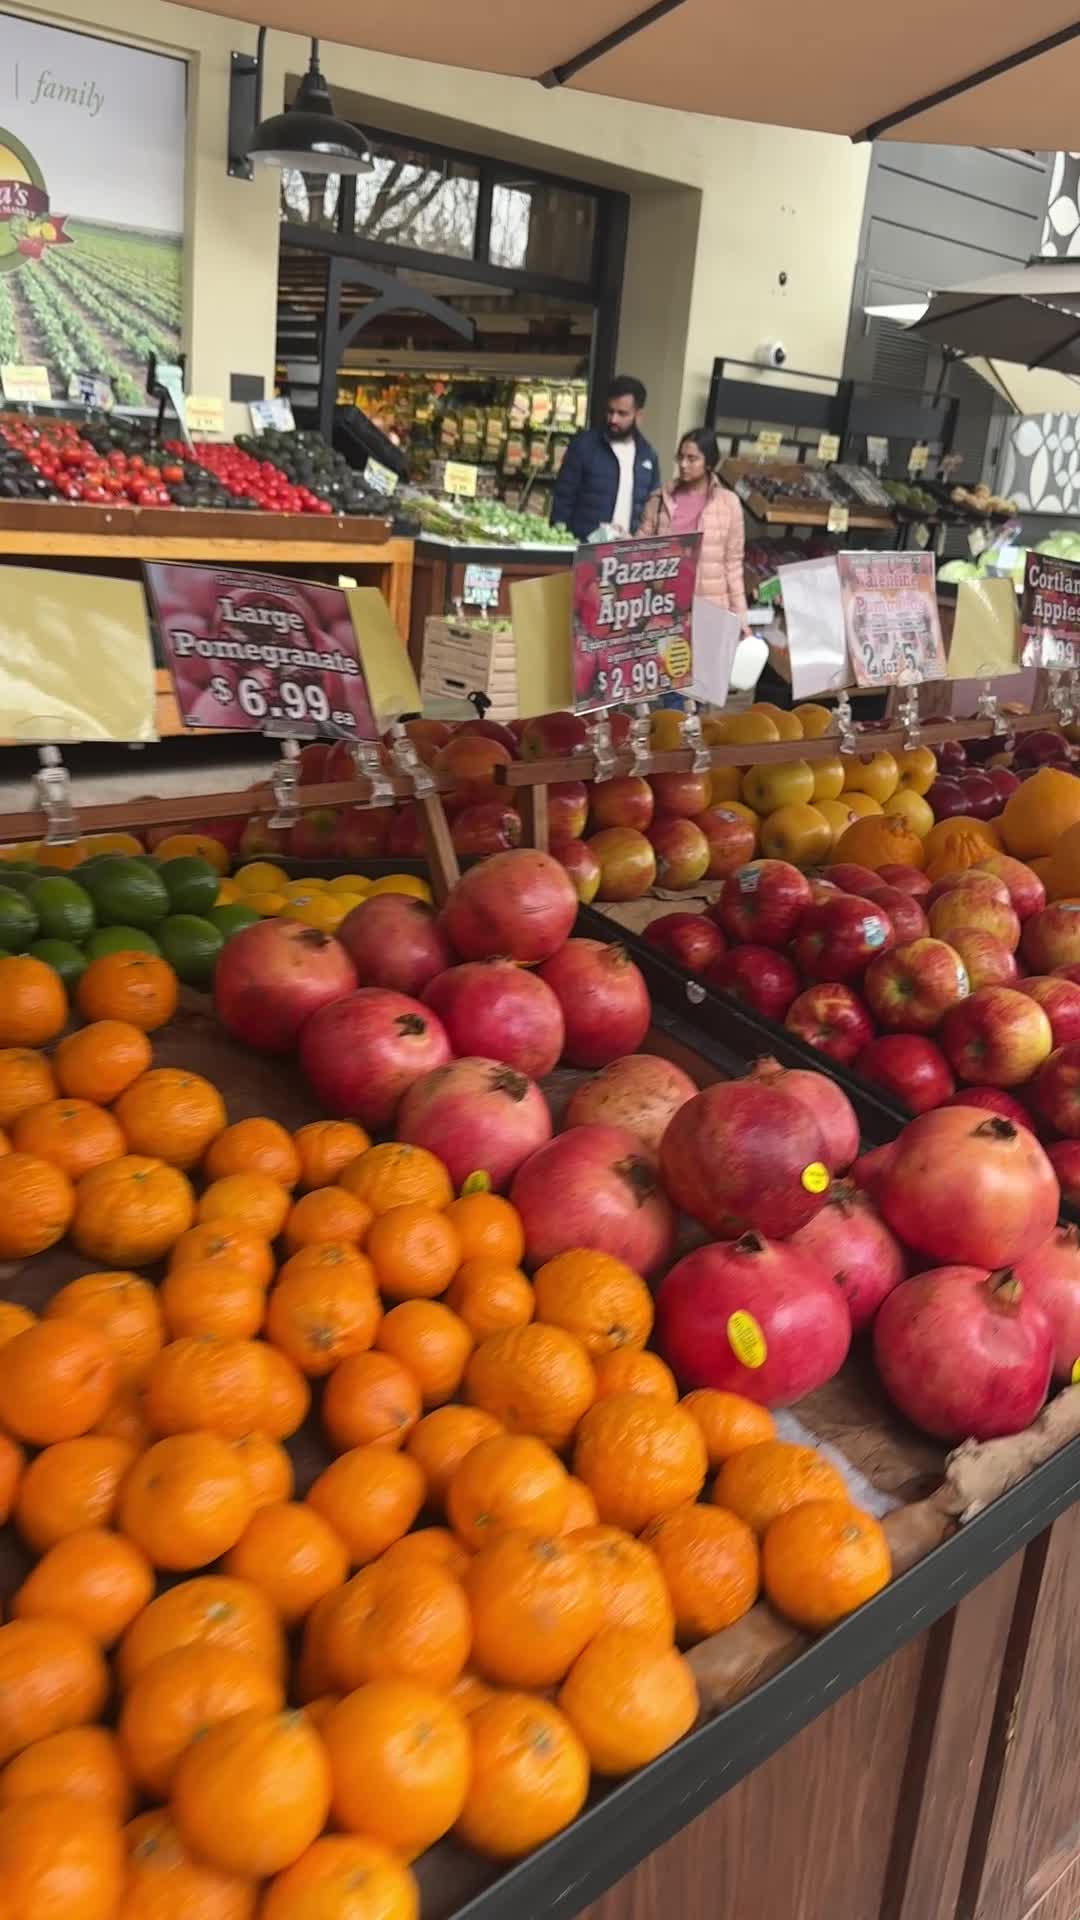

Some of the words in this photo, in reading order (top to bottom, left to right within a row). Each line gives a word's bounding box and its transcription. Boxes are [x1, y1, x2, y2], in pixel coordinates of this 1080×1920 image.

[30, 69, 105, 118] family
[598, 556, 682, 588] Pazazz
[217, 597, 305, 633] Large
[596, 588, 676, 631] Apples
[170, 630, 359, 674] Pomegranate
